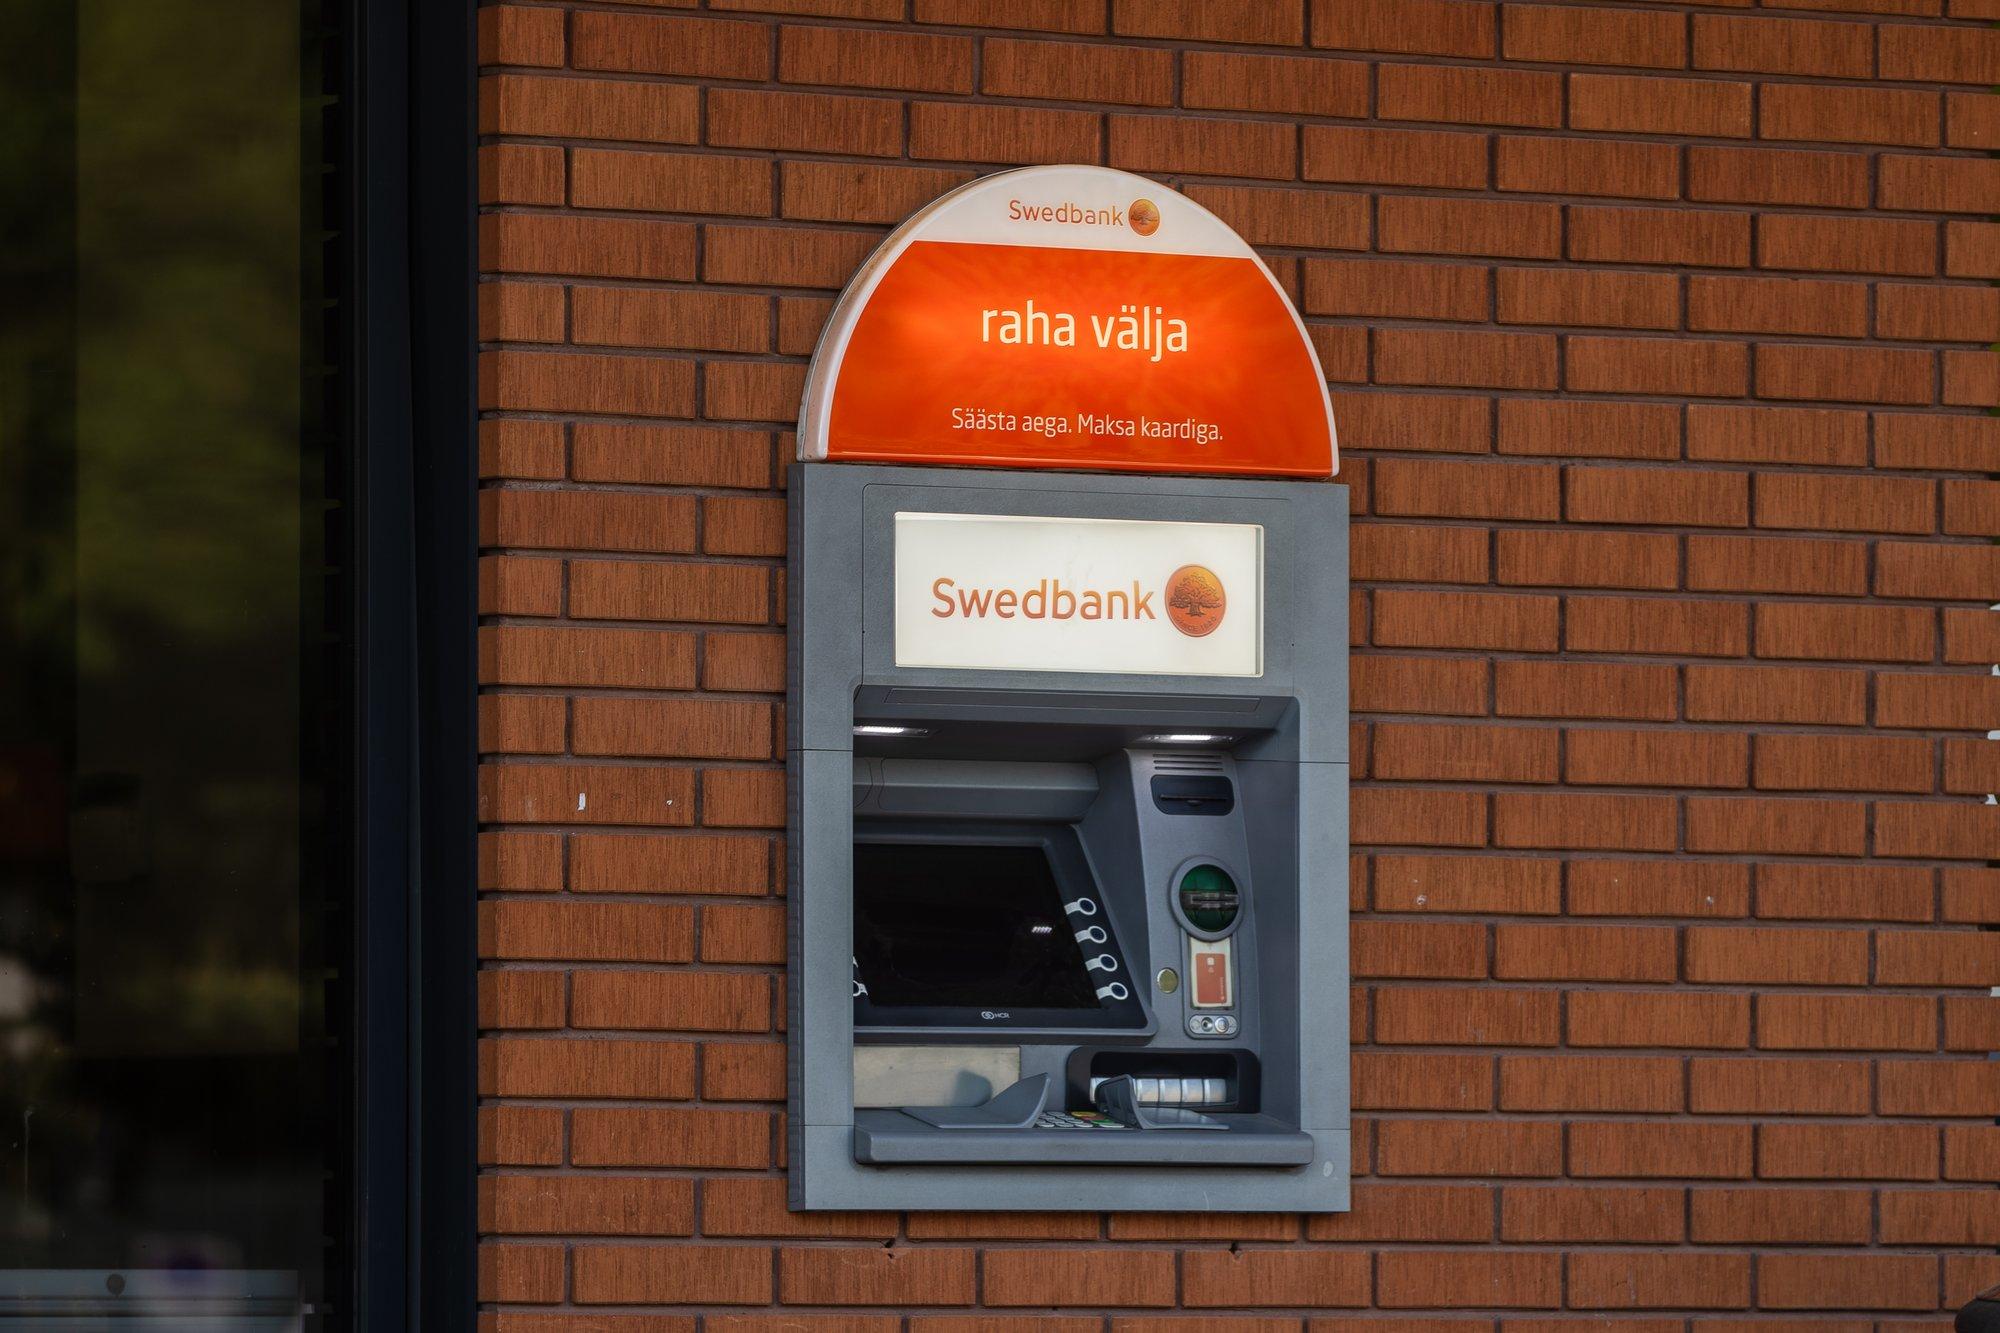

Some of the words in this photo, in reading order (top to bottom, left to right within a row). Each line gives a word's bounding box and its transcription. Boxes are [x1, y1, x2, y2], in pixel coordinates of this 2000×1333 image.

[1009, 199, 1124, 226] Swedbank
[982, 300, 1075, 347] raha
[1091, 304, 1188, 363] välja
[951, 407, 1016, 431] Säästa
[1022, 415, 1072, 437] aega.
[1078, 414, 1135, 436] Maksa
[1141, 416, 1223, 445] kaardiga.
[931, 577, 1157, 620] Swedbank
